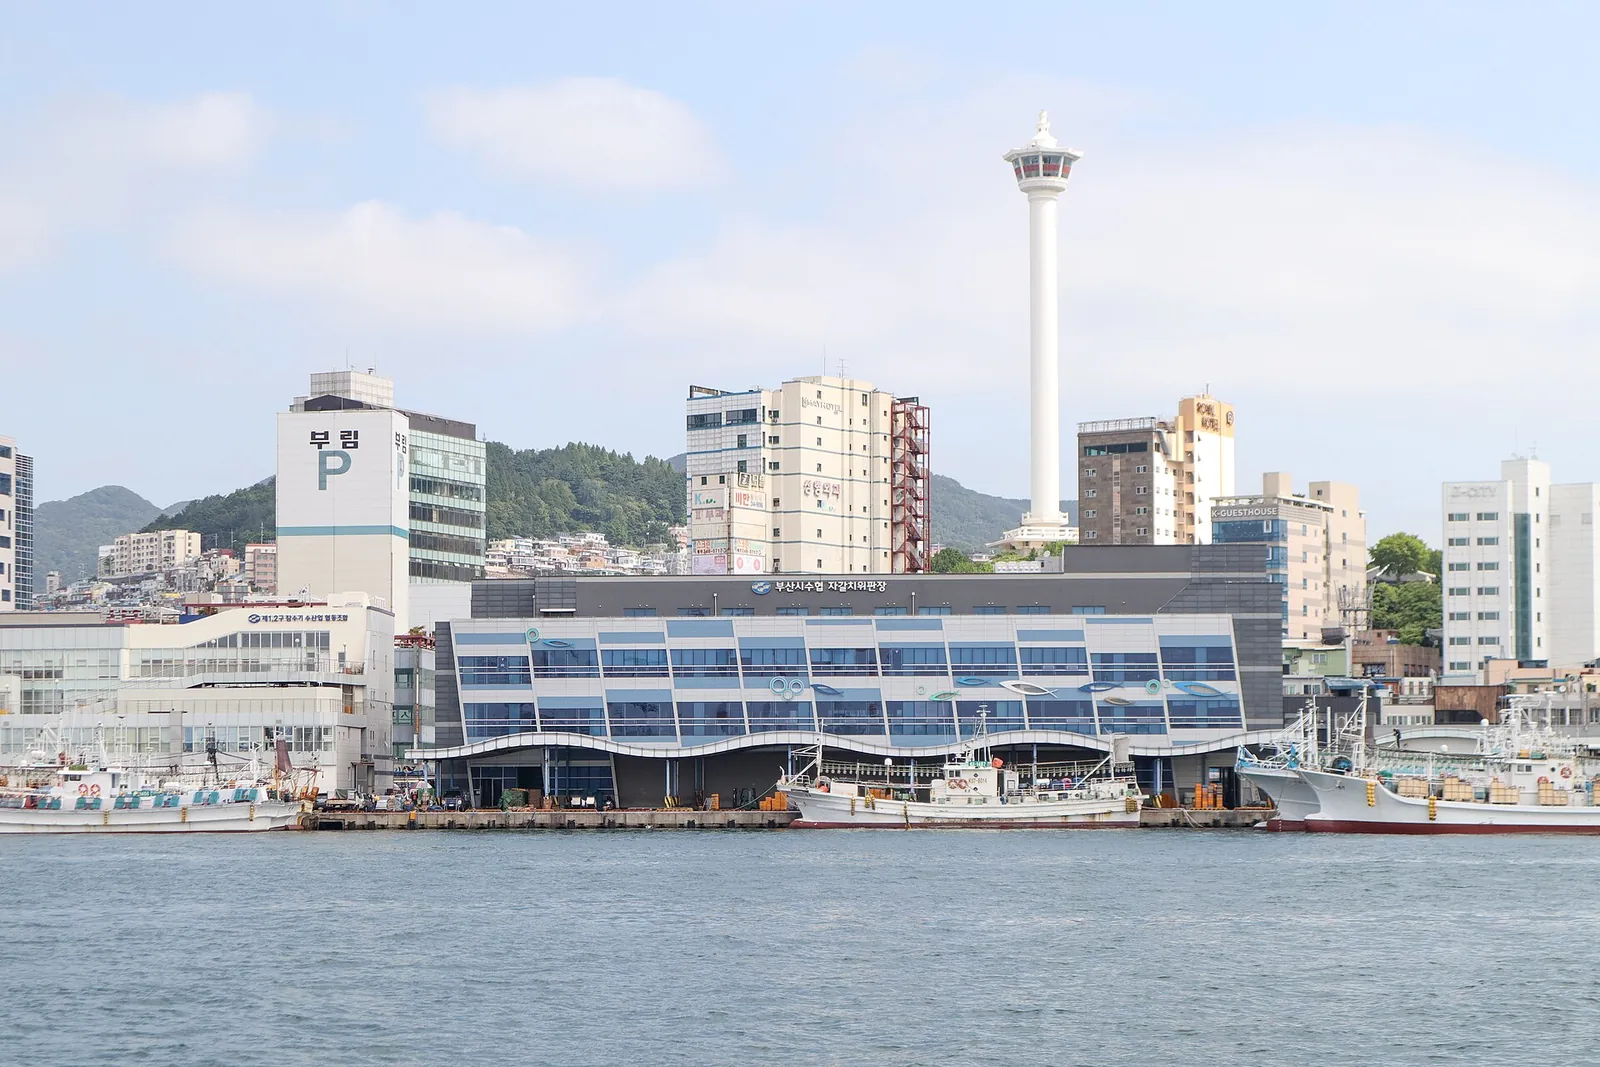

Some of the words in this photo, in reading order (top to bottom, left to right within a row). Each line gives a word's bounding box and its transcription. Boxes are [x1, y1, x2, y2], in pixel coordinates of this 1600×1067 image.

[310, 430, 358, 449] 부림
[395, 432, 407, 454] 부림
[318, 450, 352, 490] P
[397, 452, 404, 490] P
[1211, 507, 1277, 517] K-GUESTHOUSE
[775, 581, 824, 592] 부산시수협
[828, 581, 887, 593] 자갈치위판장
